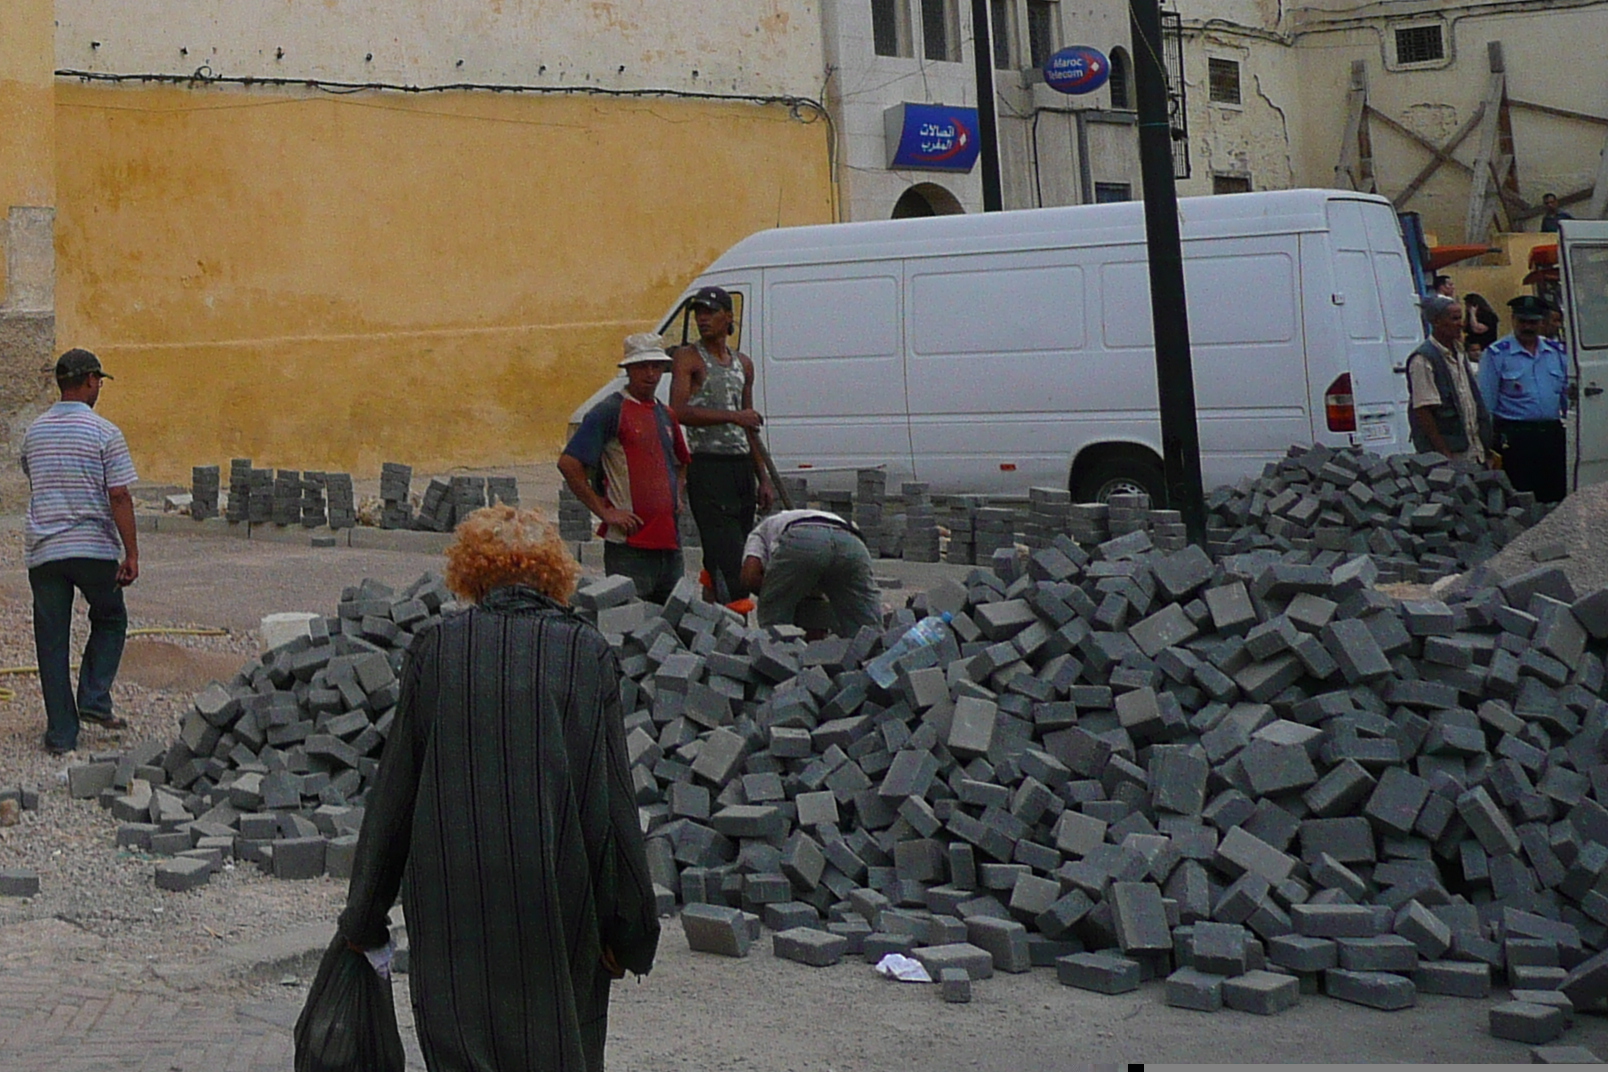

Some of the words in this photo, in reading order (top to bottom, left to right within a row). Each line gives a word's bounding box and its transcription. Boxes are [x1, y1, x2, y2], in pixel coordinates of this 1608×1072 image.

[1053, 58, 1083, 68] Maroc
[1047, 69, 1084, 80] Telecom
[919, 123, 955, 137] اتصالات
[921, 138, 953, 153] المغرب
